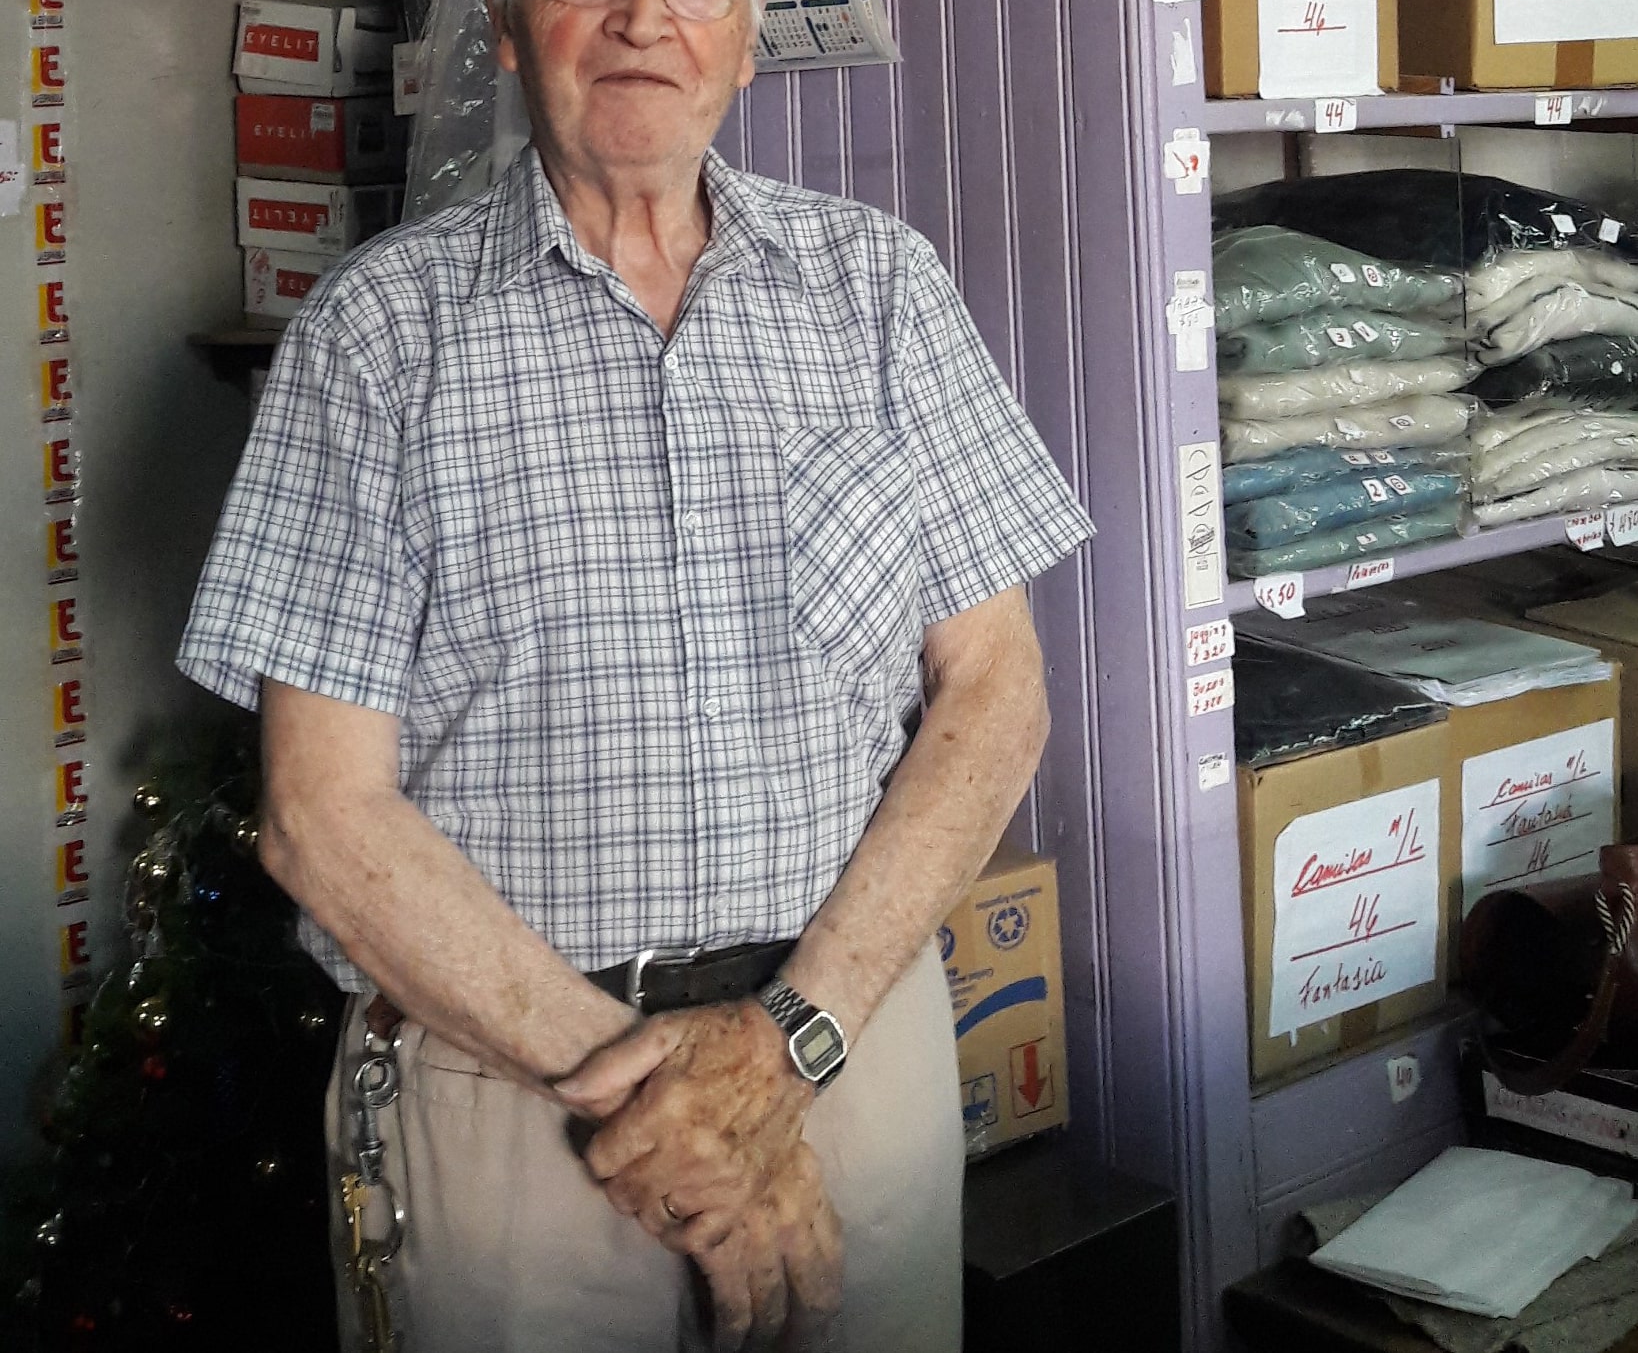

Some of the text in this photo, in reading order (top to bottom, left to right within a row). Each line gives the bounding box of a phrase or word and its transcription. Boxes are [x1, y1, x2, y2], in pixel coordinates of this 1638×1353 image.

[246, 31, 316, 53] EYELIT
[1324, 100, 1345, 128] 44
[1546, 95, 1563, 122] 44
[1369, 482, 1382, 498] 2
